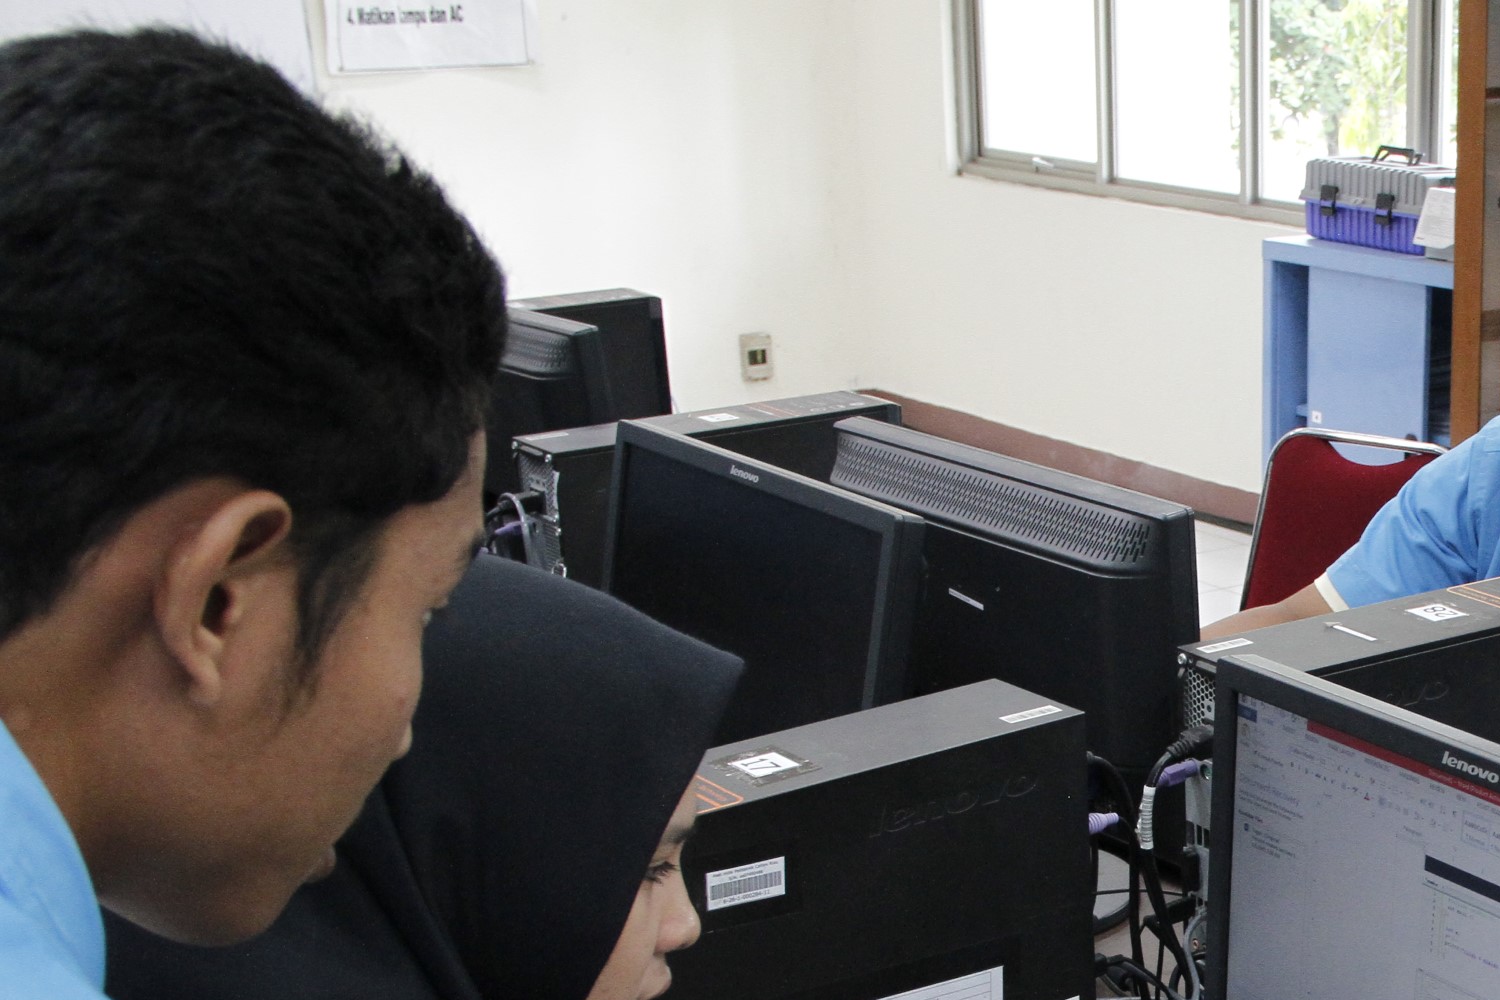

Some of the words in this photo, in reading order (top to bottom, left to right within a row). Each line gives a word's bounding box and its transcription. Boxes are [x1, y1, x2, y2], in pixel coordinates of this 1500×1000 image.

[356, 7, 397, 25] Matikan
[430, 6, 447, 24] dan
[449, 5, 464, 23] AC
[730, 465, 759, 483] lenovo
[1423, 606, 1459, 618] 28
[740, 757, 783, 772] 17
[1441, 751, 1500, 784] lenovo
